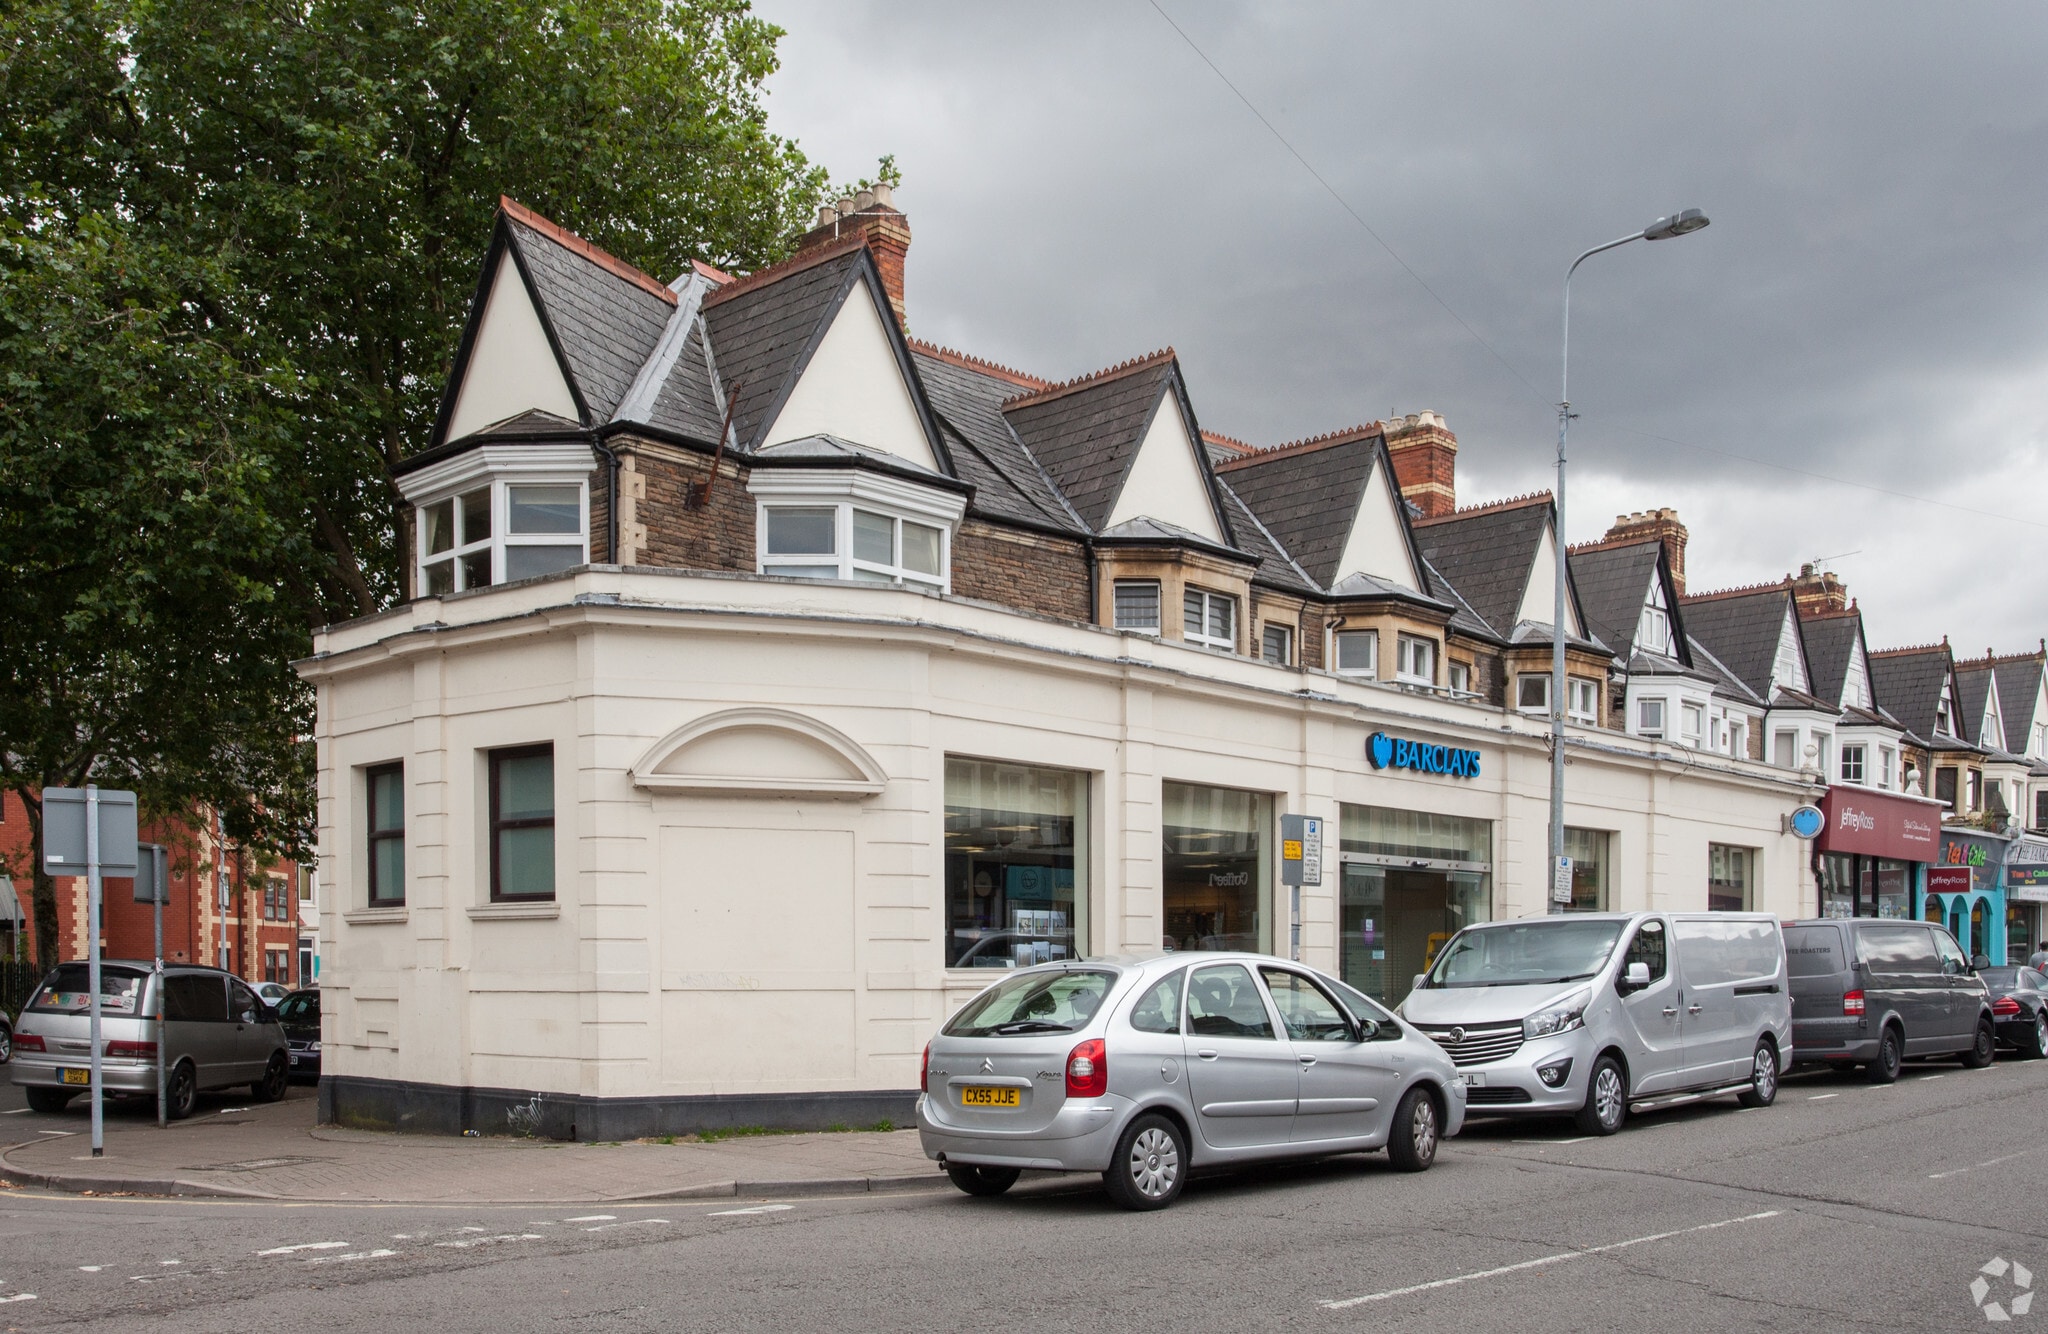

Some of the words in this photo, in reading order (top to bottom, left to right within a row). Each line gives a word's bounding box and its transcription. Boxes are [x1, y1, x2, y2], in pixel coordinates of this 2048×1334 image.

[1395, 738, 1481, 778] BARCLAYS
[1840, 807, 1874, 832] JeffreyRoss
[1947, 841, 1961, 864] Tea
[1961, 843, 1969, 864] &
[1968, 844, 1987, 867] Cake
[1930, 876, 1967, 886] JeffreyRoss
[1458, 1074, 1478, 1085] JL
[966, 1089, 992, 1103] CX55
[994, 1089, 1015, 1104] JJE
